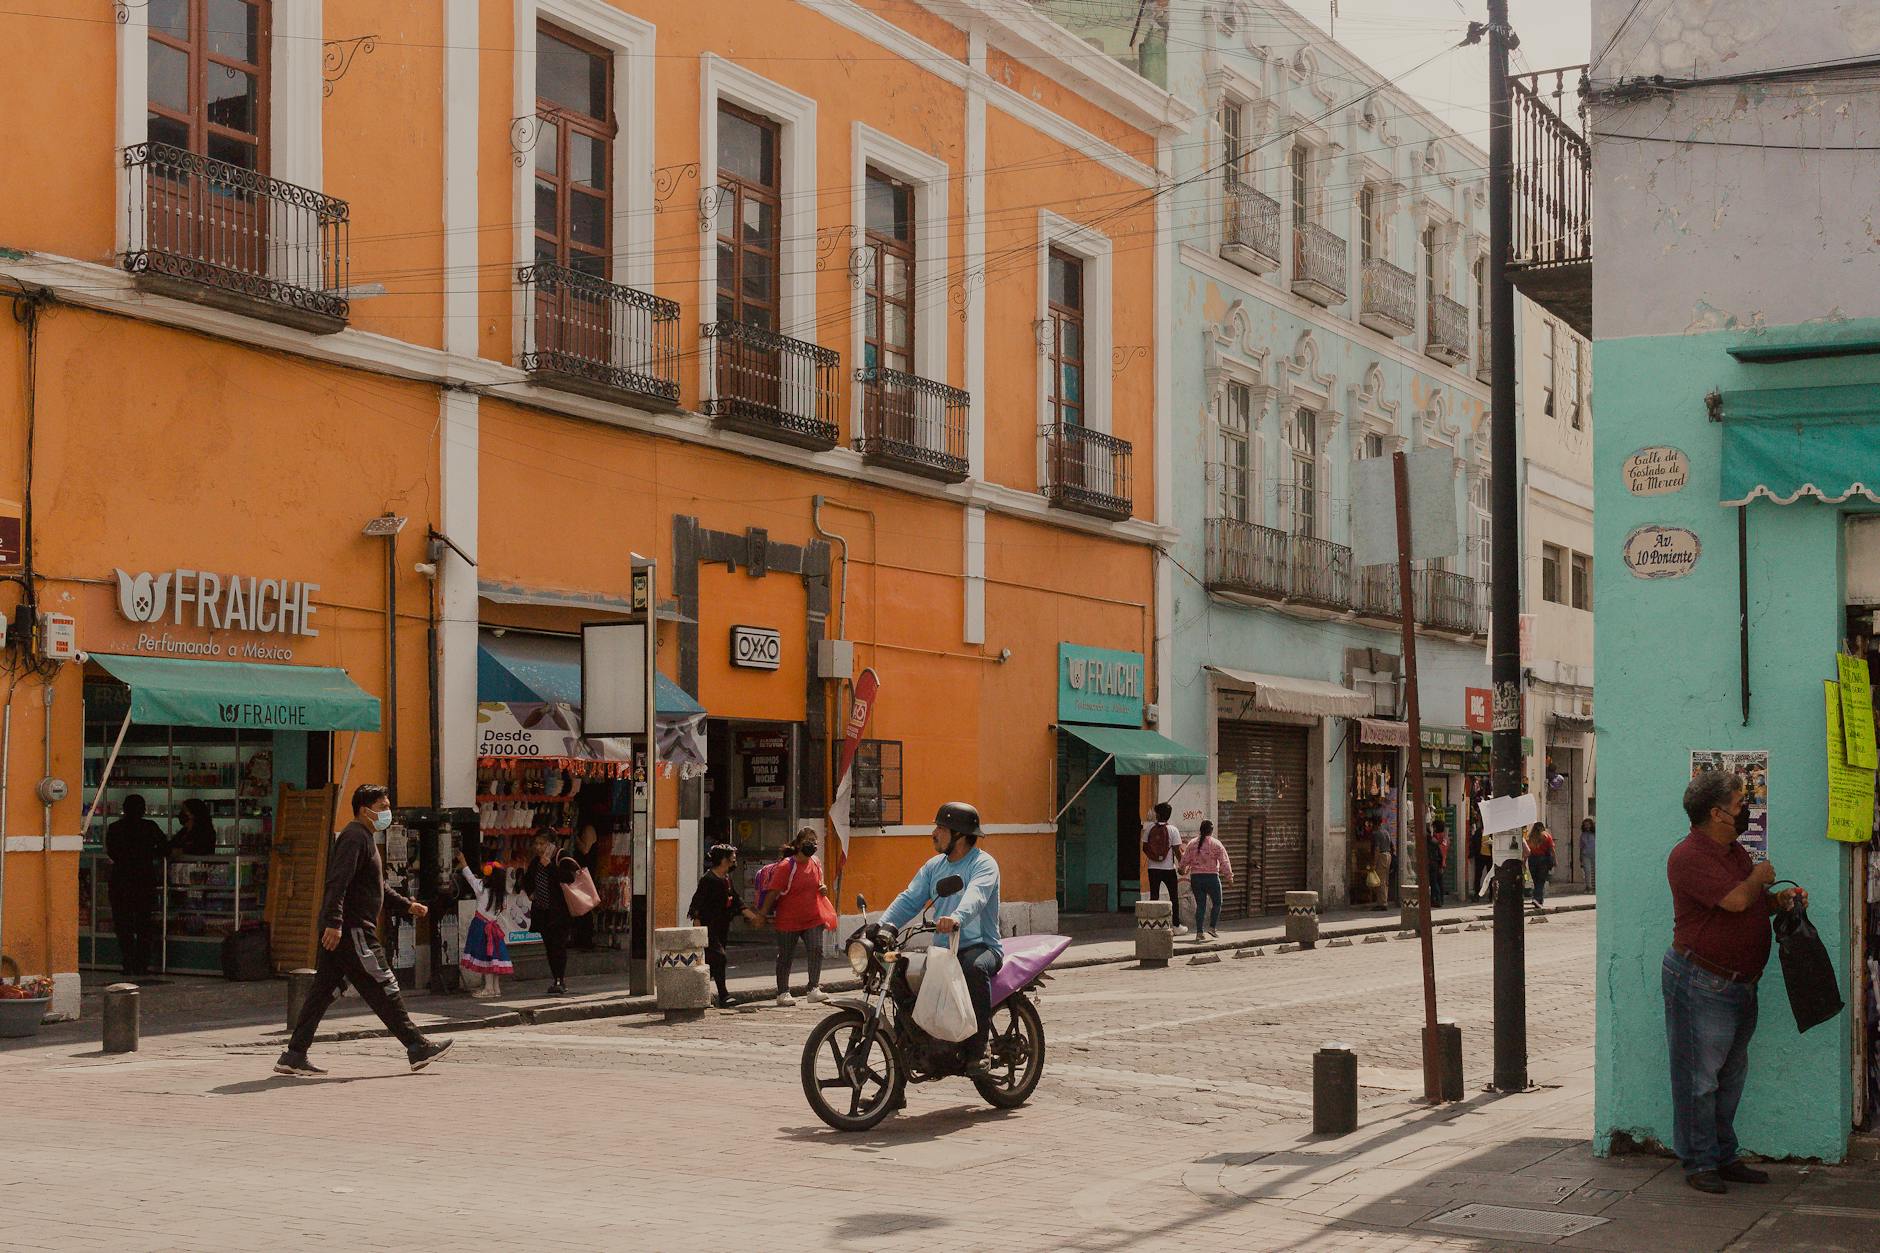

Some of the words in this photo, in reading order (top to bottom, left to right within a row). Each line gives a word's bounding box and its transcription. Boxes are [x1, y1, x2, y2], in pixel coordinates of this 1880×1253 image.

[1665, 449, 1678, 462] del
[1669, 462, 1680, 474] de
[1632, 478, 1643, 492] la
[1647, 474, 1685, 490] Merced
[1654, 533, 1673, 548] Av.
[1635, 550, 1649, 566] 10
[1650, 548, 1693, 565] Poniente
[174, 568, 321, 637] FRAICHE
[138, 632, 220, 656] Perfumando
[228, 644, 237, 657] a
[243, 640, 293, 661] México
[738, 634, 780, 661] OXXO
[1087, 658, 1140, 698] FRAICHE
[243, 703, 307, 725] FRAICHE
[1470, 695, 1485, 716] BIG
[484, 729, 532, 742] Desde
[479, 742, 539, 756] $100.00
